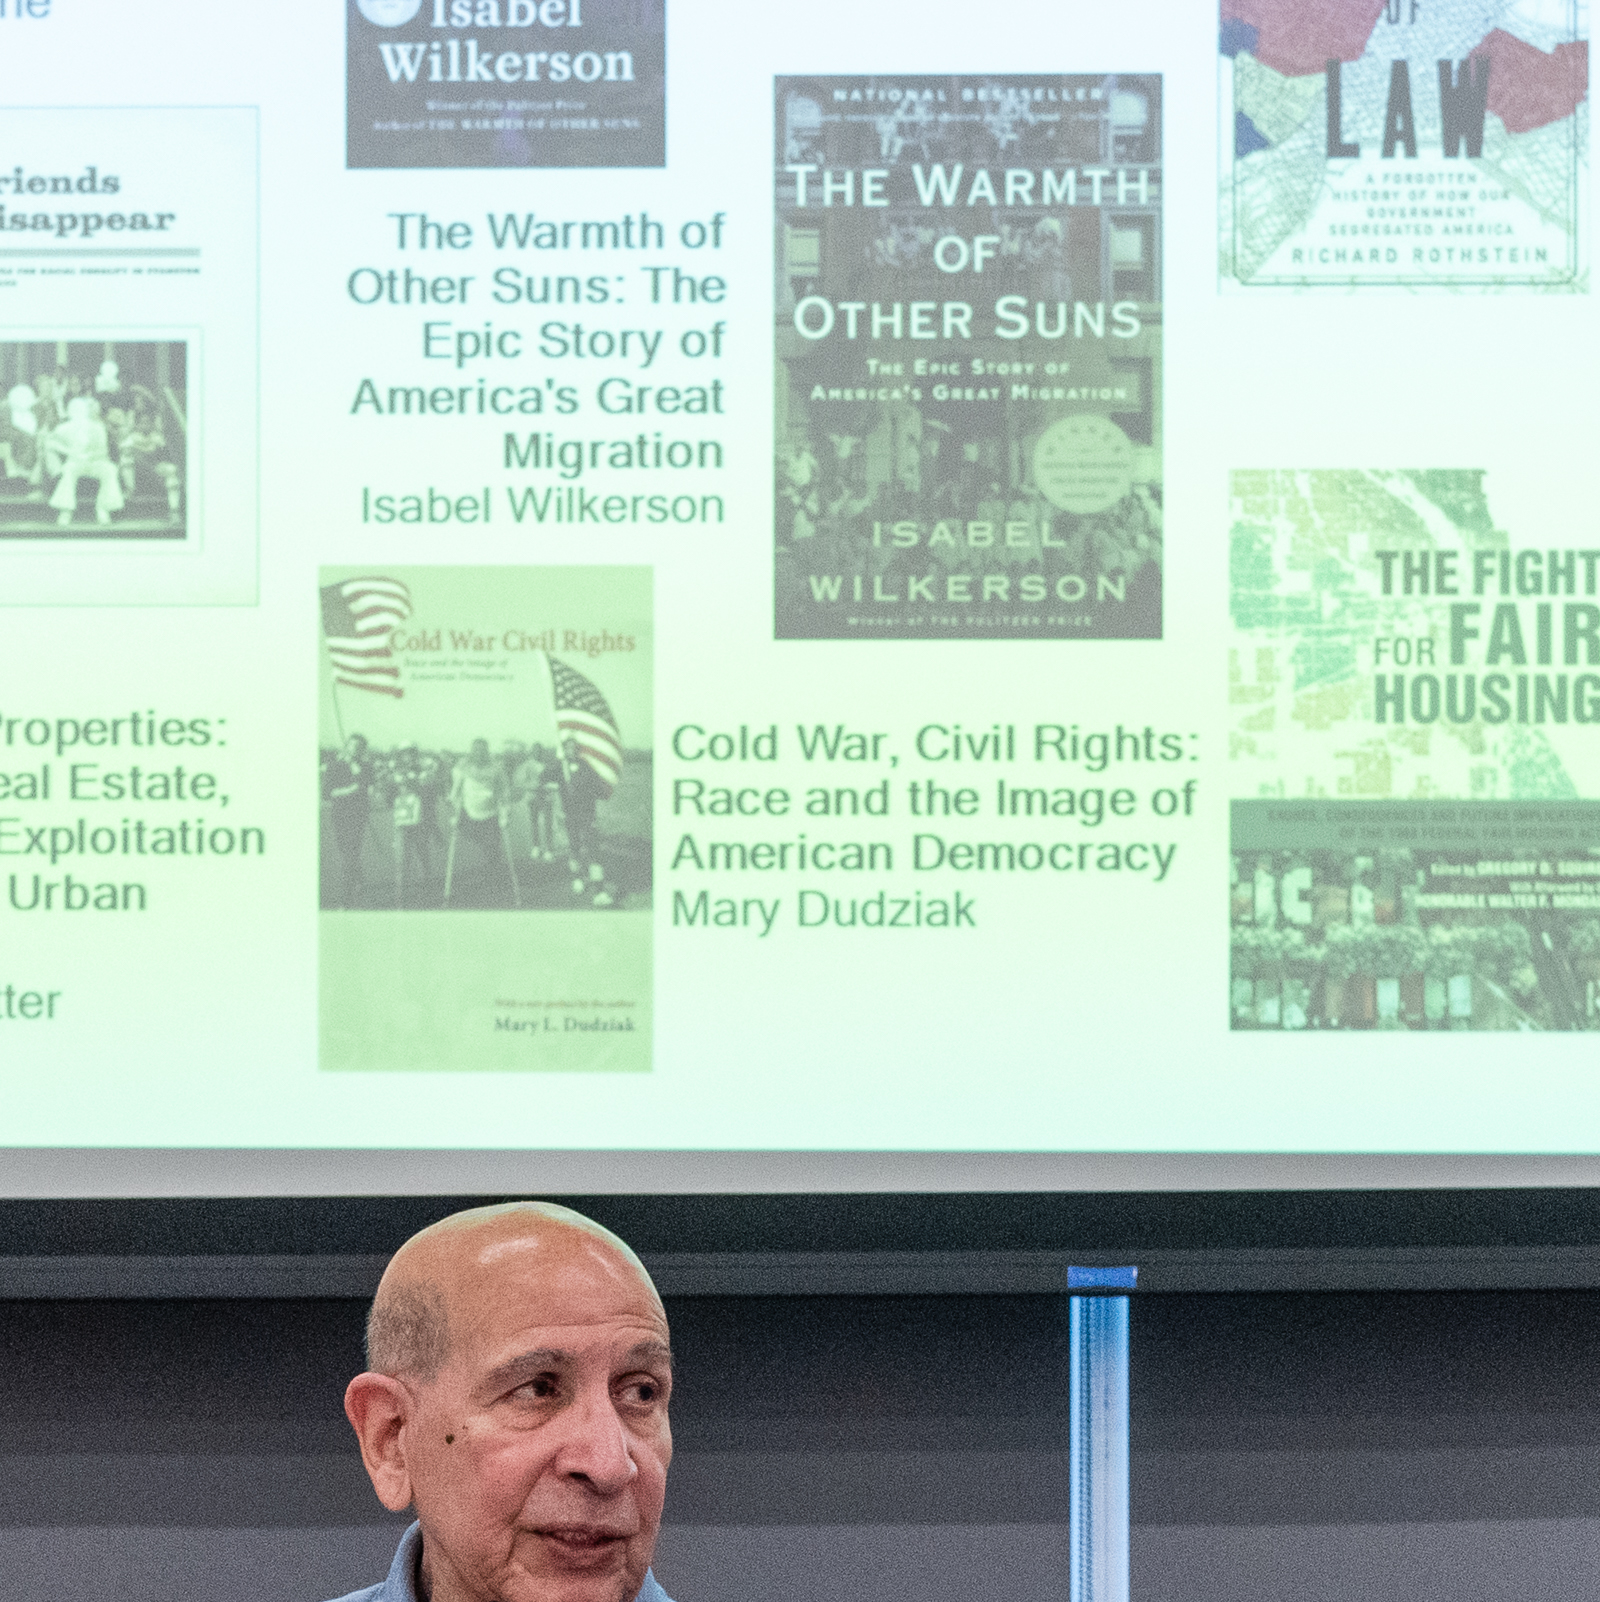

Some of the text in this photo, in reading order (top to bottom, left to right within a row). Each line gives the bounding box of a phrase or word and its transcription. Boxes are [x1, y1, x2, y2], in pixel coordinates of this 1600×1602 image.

[433, 0, 580, 27] Isabel
[380, 38, 633, 82] Wilkerson
[1326, 58, 1492, 160] LAW
[785, 161, 1149, 207] THE WARMTH
[389, 212, 725, 250] The Warmth of
[1329, 223, 1513, 236] SEGREGATED AMERICA
[1367, 206, 1474, 218] GOVERNMENT
[934, 234, 1000, 272] OF
[1291, 246, 1548, 264] RICHARD ROTHSTEIN
[347, 266, 727, 305] Other Suns: The
[794, 296, 1141, 339] OTHER SUNS
[350, 377, 724, 415] America's Great
[873, 520, 1067, 549] ISABEL
[809, 574, 1125, 602] WILKERSON
[1374, 548, 1459, 597] THE
[389, 629, 637, 658] Cold War Civil Rights
[1374, 634, 1436, 667] FOR
[672, 724, 1197, 773] Cold War, Civil Rights:
[70, 763, 229, 807] Estate,
[673, 779, 1196, 829] Race and the Image of
